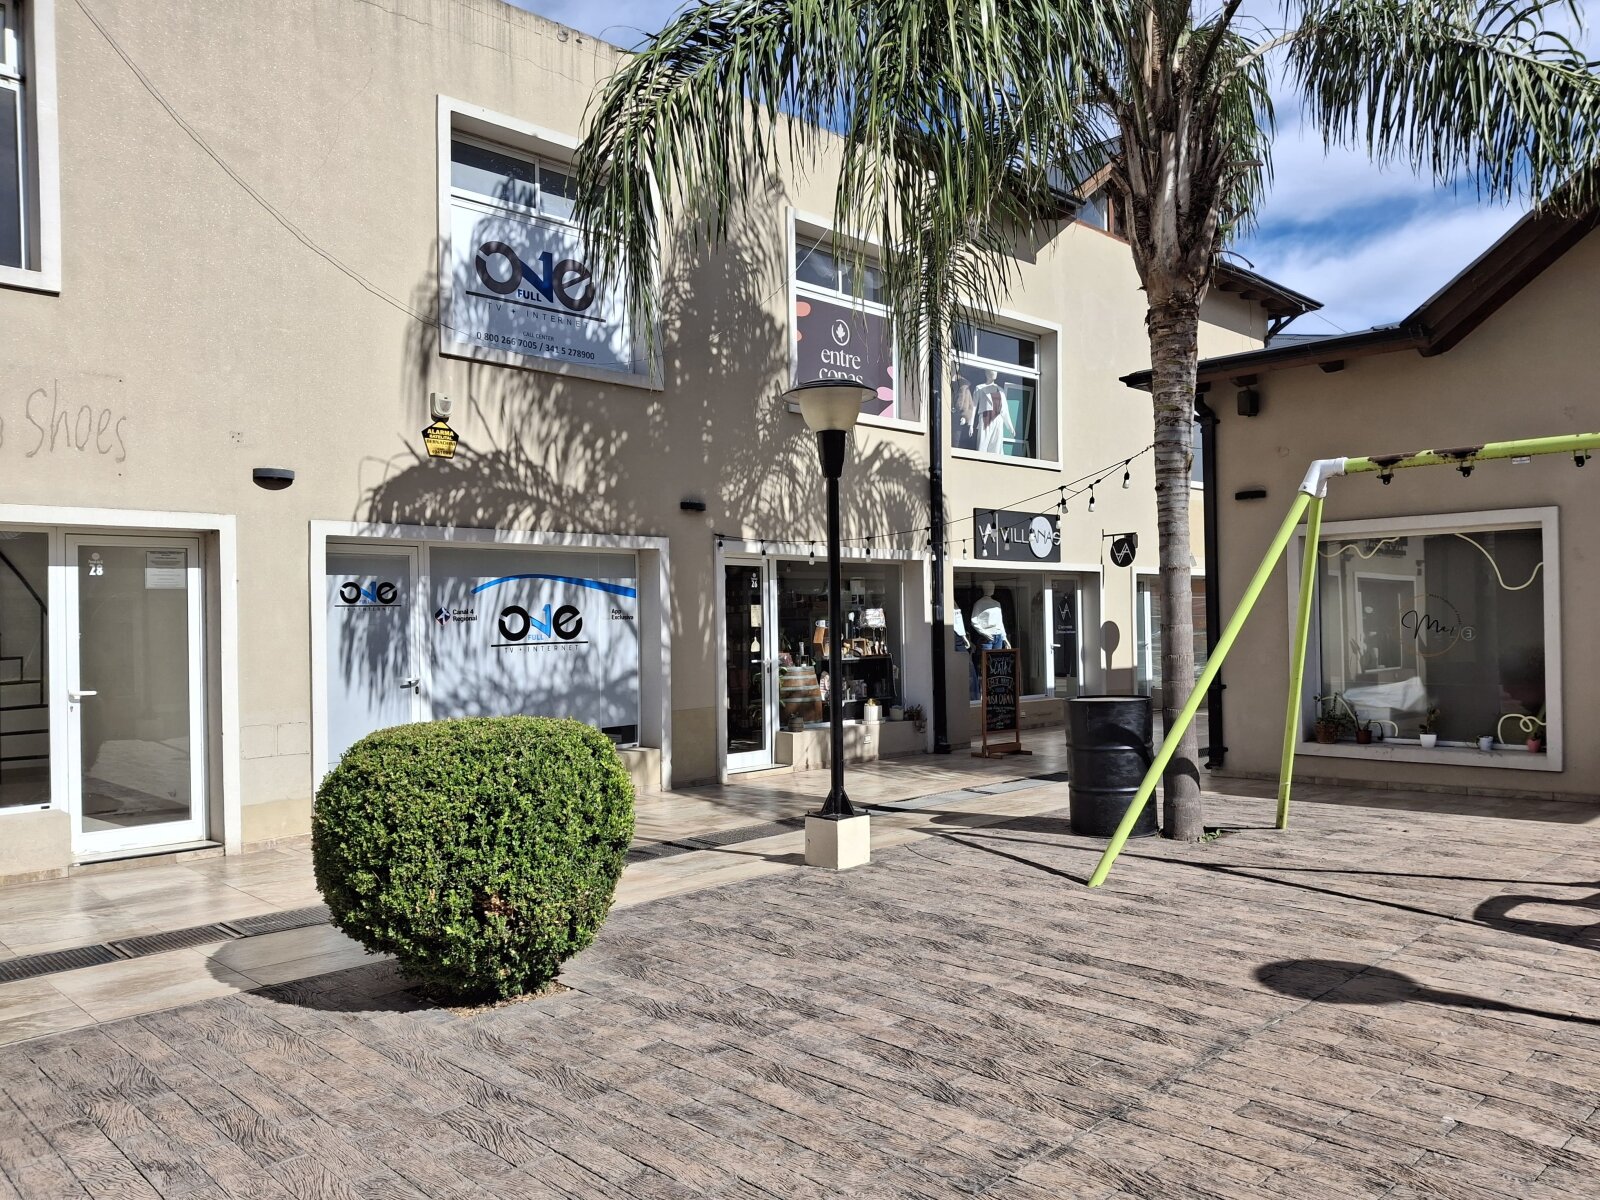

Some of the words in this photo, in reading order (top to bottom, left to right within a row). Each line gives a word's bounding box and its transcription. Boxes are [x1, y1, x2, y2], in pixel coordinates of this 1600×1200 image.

[517, 288, 542, 302] FULL
[486, 302, 502, 311] TV
[526, 310, 589, 327] INTERNET
[536, 333, 555, 341] CENTER
[476, 331, 482, 340] 0
[484, 332, 499, 343] 800
[501, 335, 516, 345] 266
[518, 338, 537, 350] 7005
[546, 343, 560, 354] 341
[568, 347, 595, 360] 278900
[821, 348, 861, 370] entre
[25, 378, 127, 463] Shoes
[427, 428, 454, 437] ALARMA
[88, 564, 104, 576] 28
[452, 615, 478, 623] Regional
[527, 644, 579, 653] INTERNET
